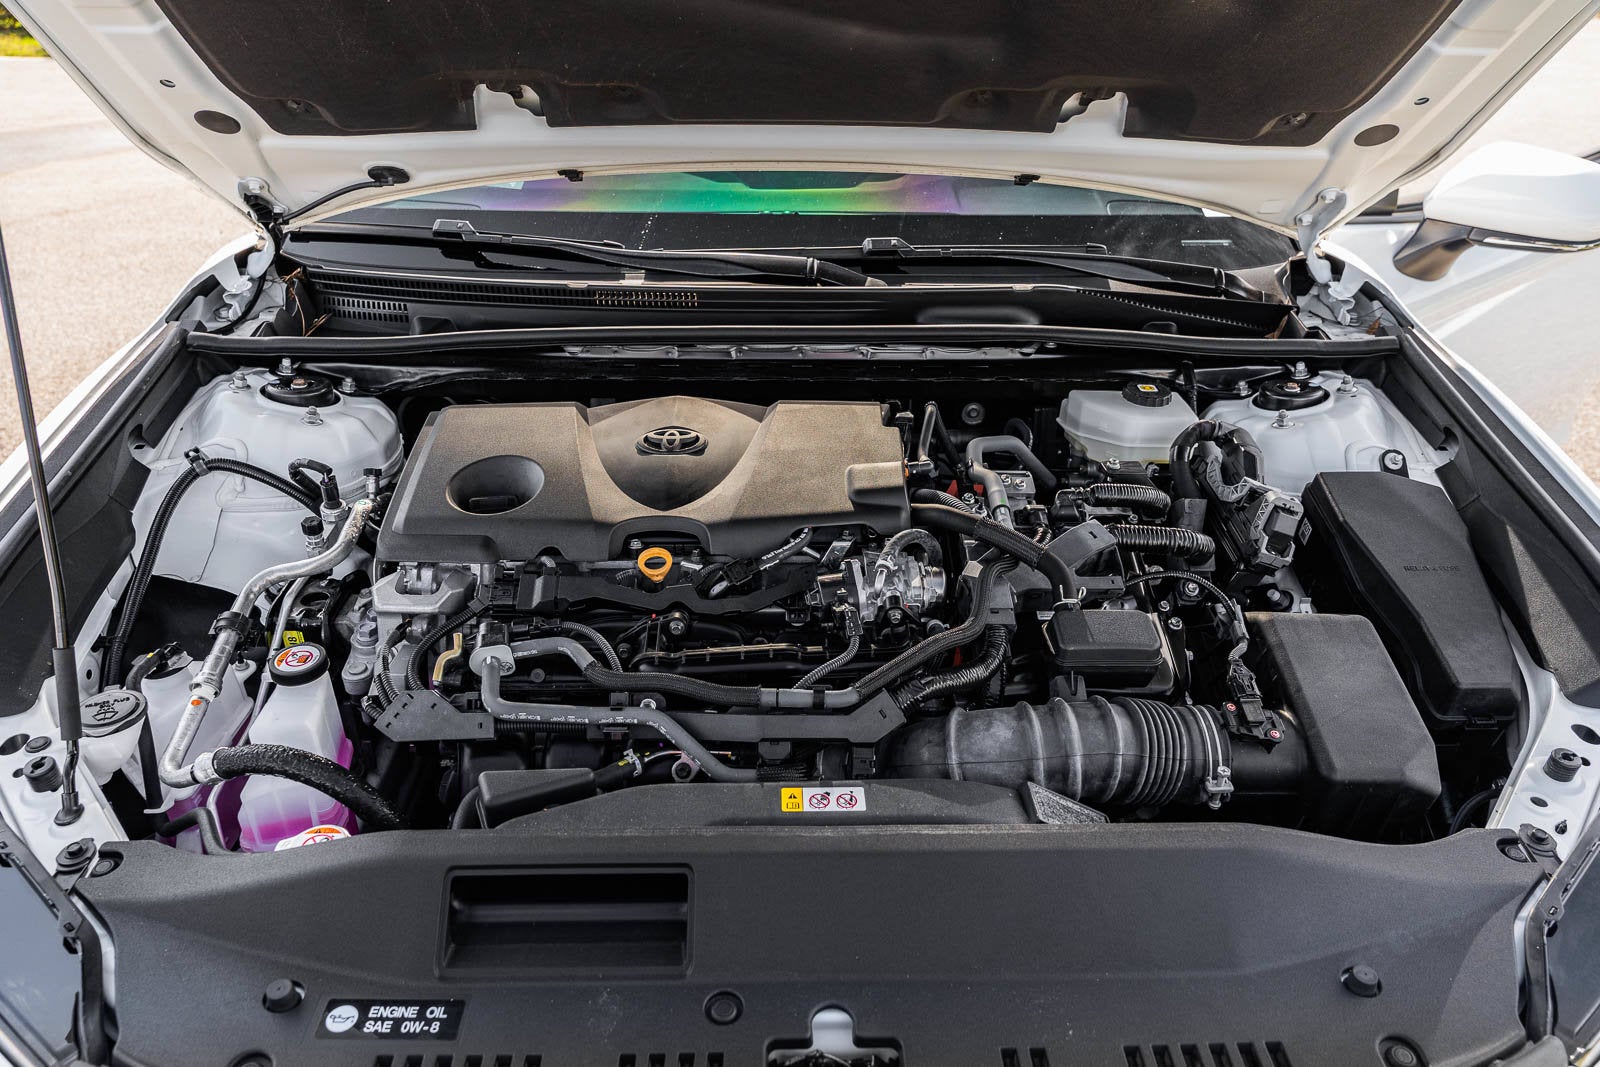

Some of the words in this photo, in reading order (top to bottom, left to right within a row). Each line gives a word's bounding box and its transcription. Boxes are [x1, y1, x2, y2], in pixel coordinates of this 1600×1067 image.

[367, 1005, 420, 1019] ENGINE
[425, 1006, 448, 1019] OIL
[362, 1020, 394, 1033] SAE
[400, 1021, 440, 1034] 0W-8
